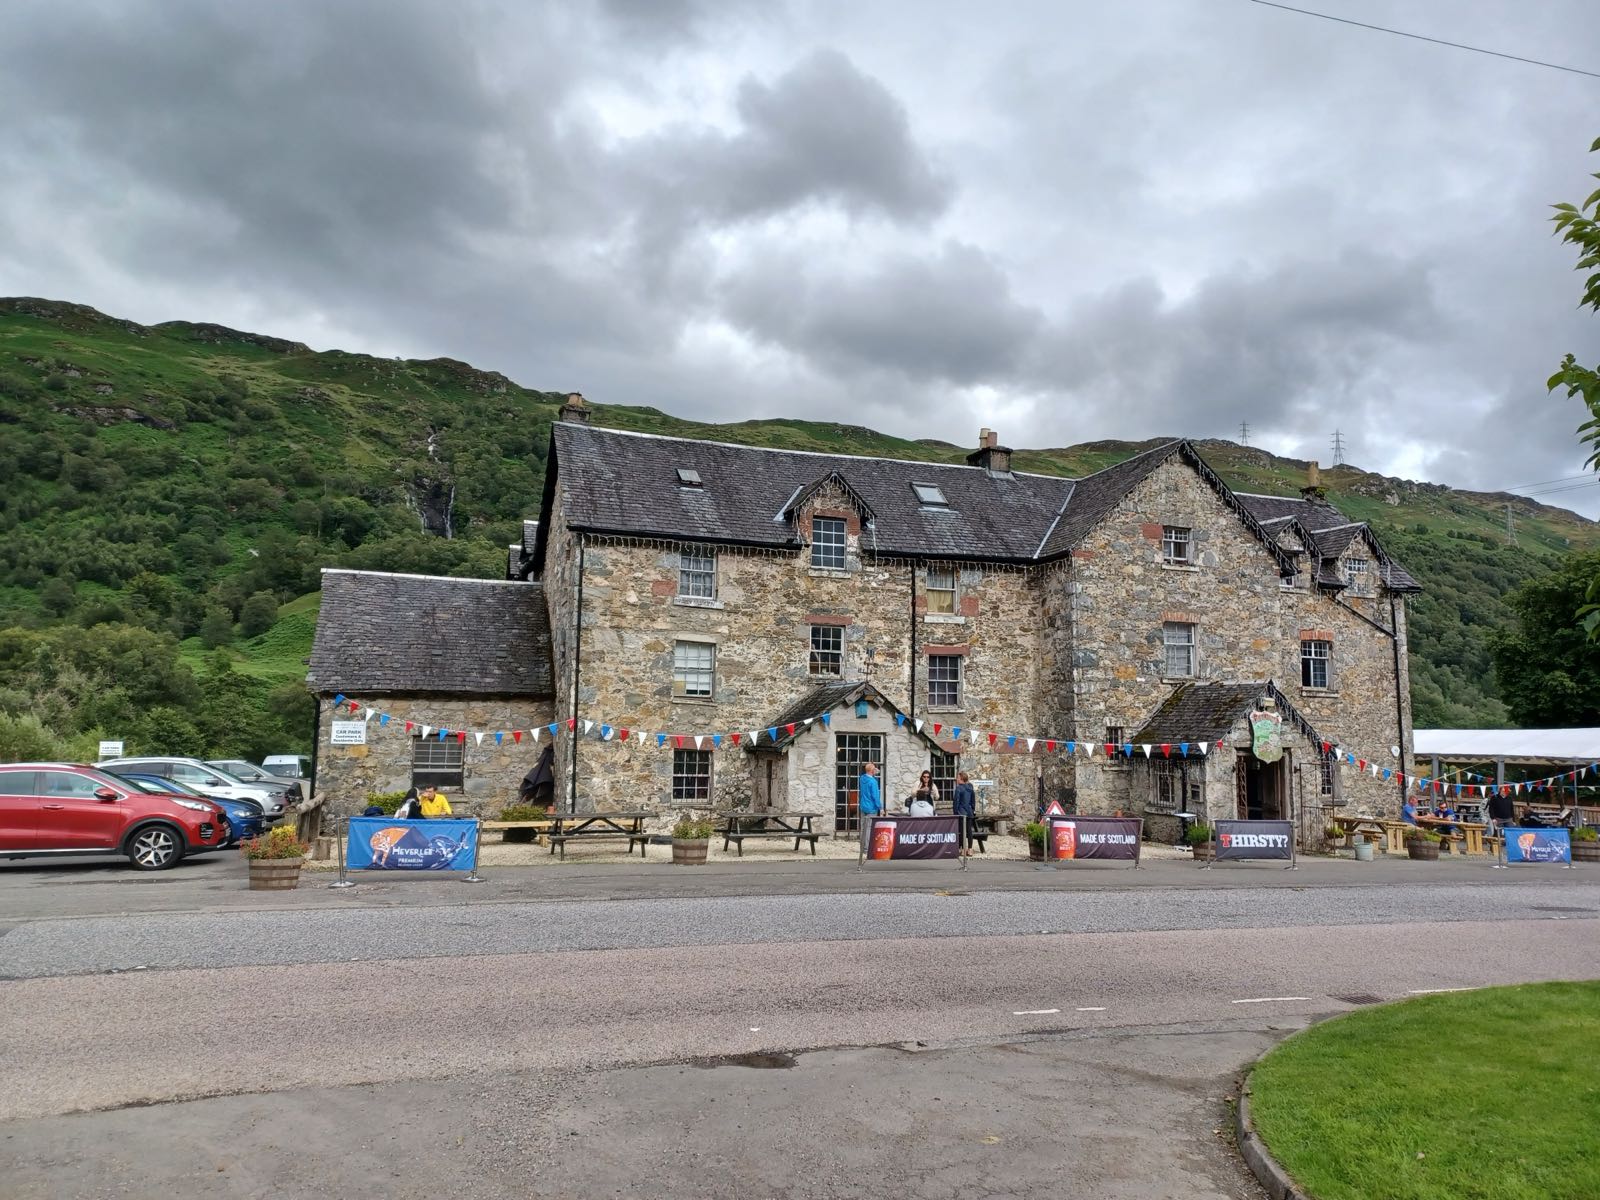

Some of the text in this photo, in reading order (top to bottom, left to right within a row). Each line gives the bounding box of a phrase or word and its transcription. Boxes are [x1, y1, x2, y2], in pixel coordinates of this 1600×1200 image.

[900, 834, 917, 844] MADE
[917, 834, 927, 844] OF
[926, 833, 957, 844] SCOTLAND
[1080, 834, 1098, 844] MADE
[1098, 834, 1106, 844] OF
[1106, 834, 1136, 844] SCOTLAND
[1219, 833, 1288, 848] THIRSTY?
